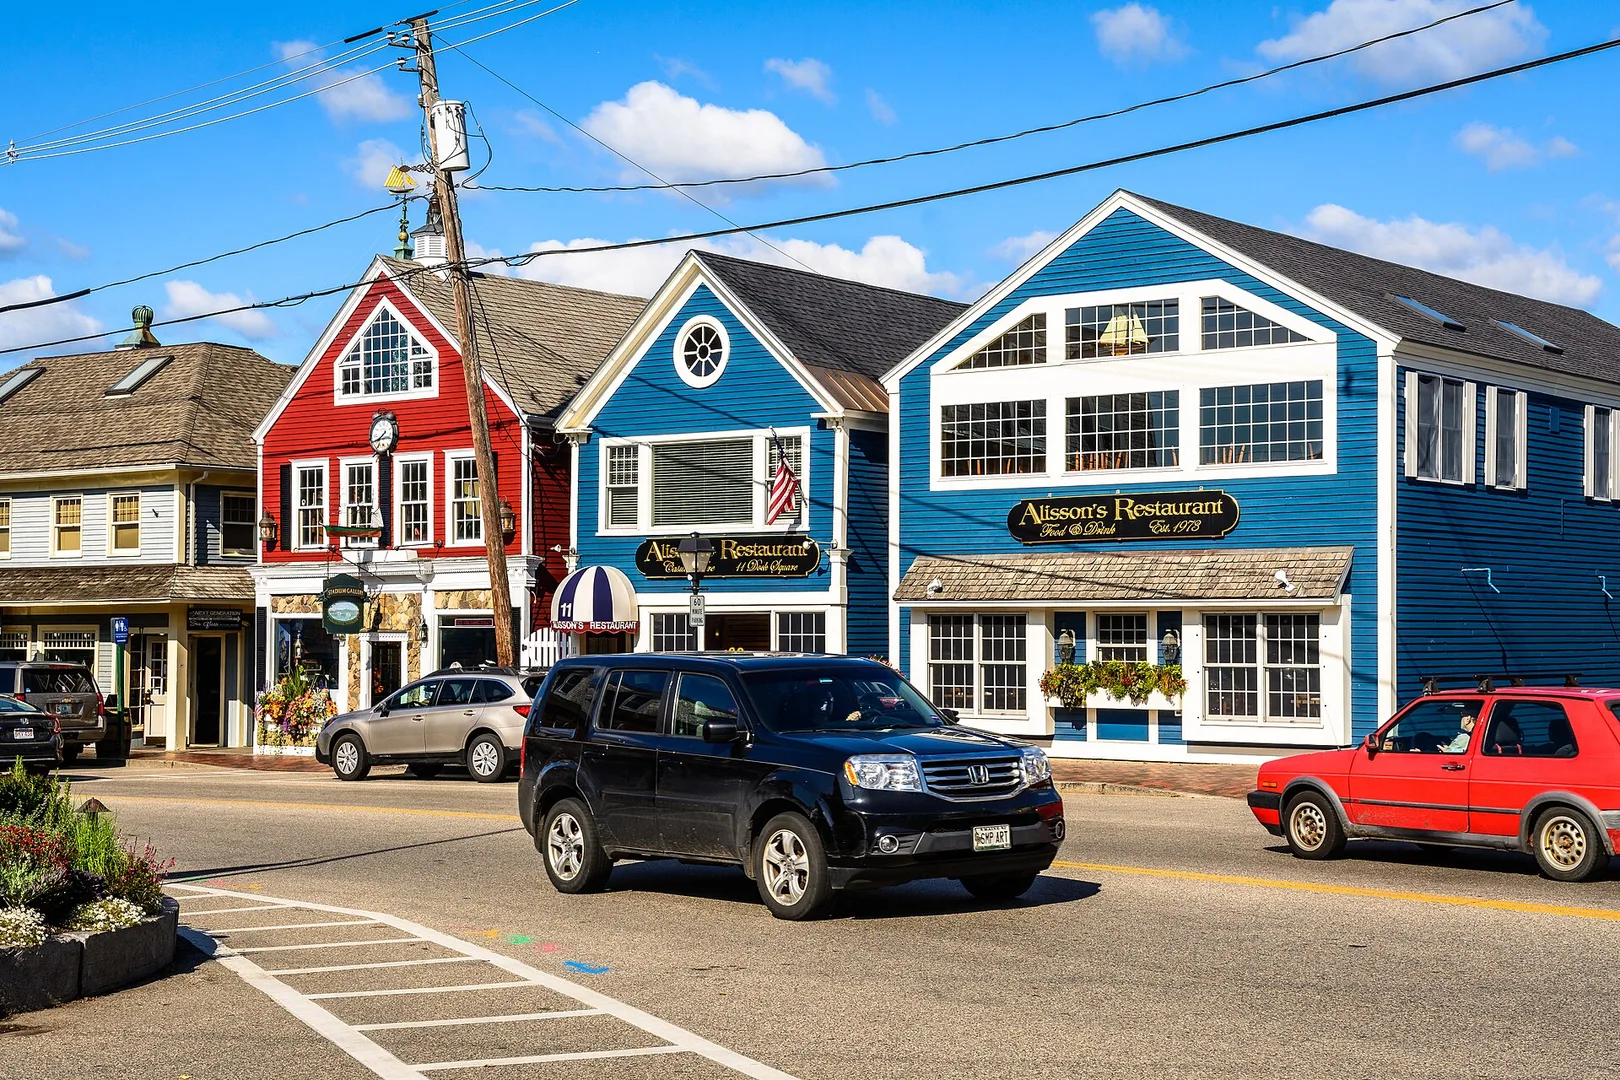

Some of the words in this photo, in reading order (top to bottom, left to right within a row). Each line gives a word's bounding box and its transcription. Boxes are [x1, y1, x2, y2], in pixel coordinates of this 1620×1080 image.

[1018, 502, 1108, 525] Alisson's
[1114, 498, 1223, 521] Restaurant
[1039, 522, 1068, 537] Food
[1083, 521, 1116, 536] Drink
[1148, 519, 1171, 534] Est.
[746, 559, 769, 572] Dock
[769, 559, 798, 574] Square
[327, 587, 346, 596] STADIUM
[346, 587, 364, 596] GALLERY
[560, 602, 572, 617] 11
[693, 598, 701, 606] 60
[589, 621, 637, 630] RESTAURANT
[995, 830, 1008, 844] ART
